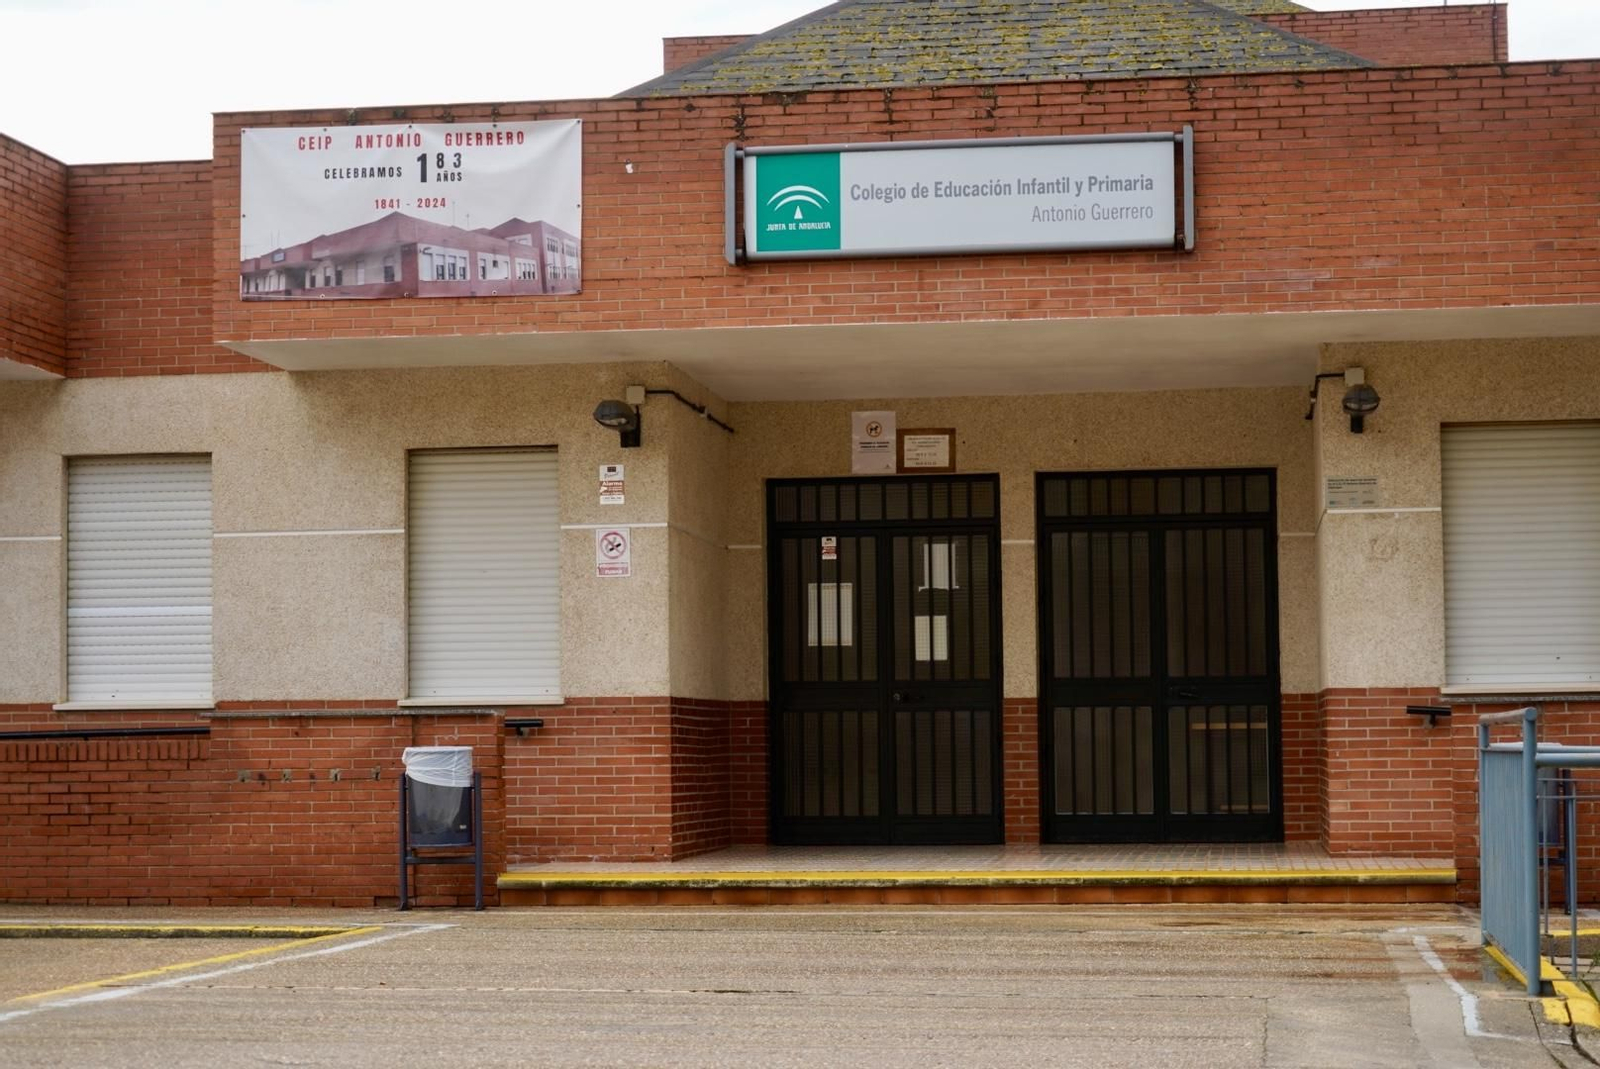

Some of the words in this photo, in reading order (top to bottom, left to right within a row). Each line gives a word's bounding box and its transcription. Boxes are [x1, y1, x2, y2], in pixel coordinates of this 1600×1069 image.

[298, 135, 332, 151] CEIP
[355, 132, 422, 149] ANTONIO
[445, 130, 525, 147] GUERRERO
[324, 166, 403, 180] CELEBRAMOS
[436, 169, 463, 183] AÑOS
[850, 182, 907, 204] Colegio
[910, 181, 930, 199] de
[934, 178, 1012, 198] Educación
[1017, 176, 1071, 195] Infantil
[1074, 181, 1083, 198] y
[1088, 173, 1154, 193] Primaria
[374, 198, 400, 210] 1841
[417, 197, 447, 209] 2024
[1031, 204, 1086, 223] Antonio
[1091, 203, 1154, 221] Guerrero
[766, 223, 786, 231] JUNTA
